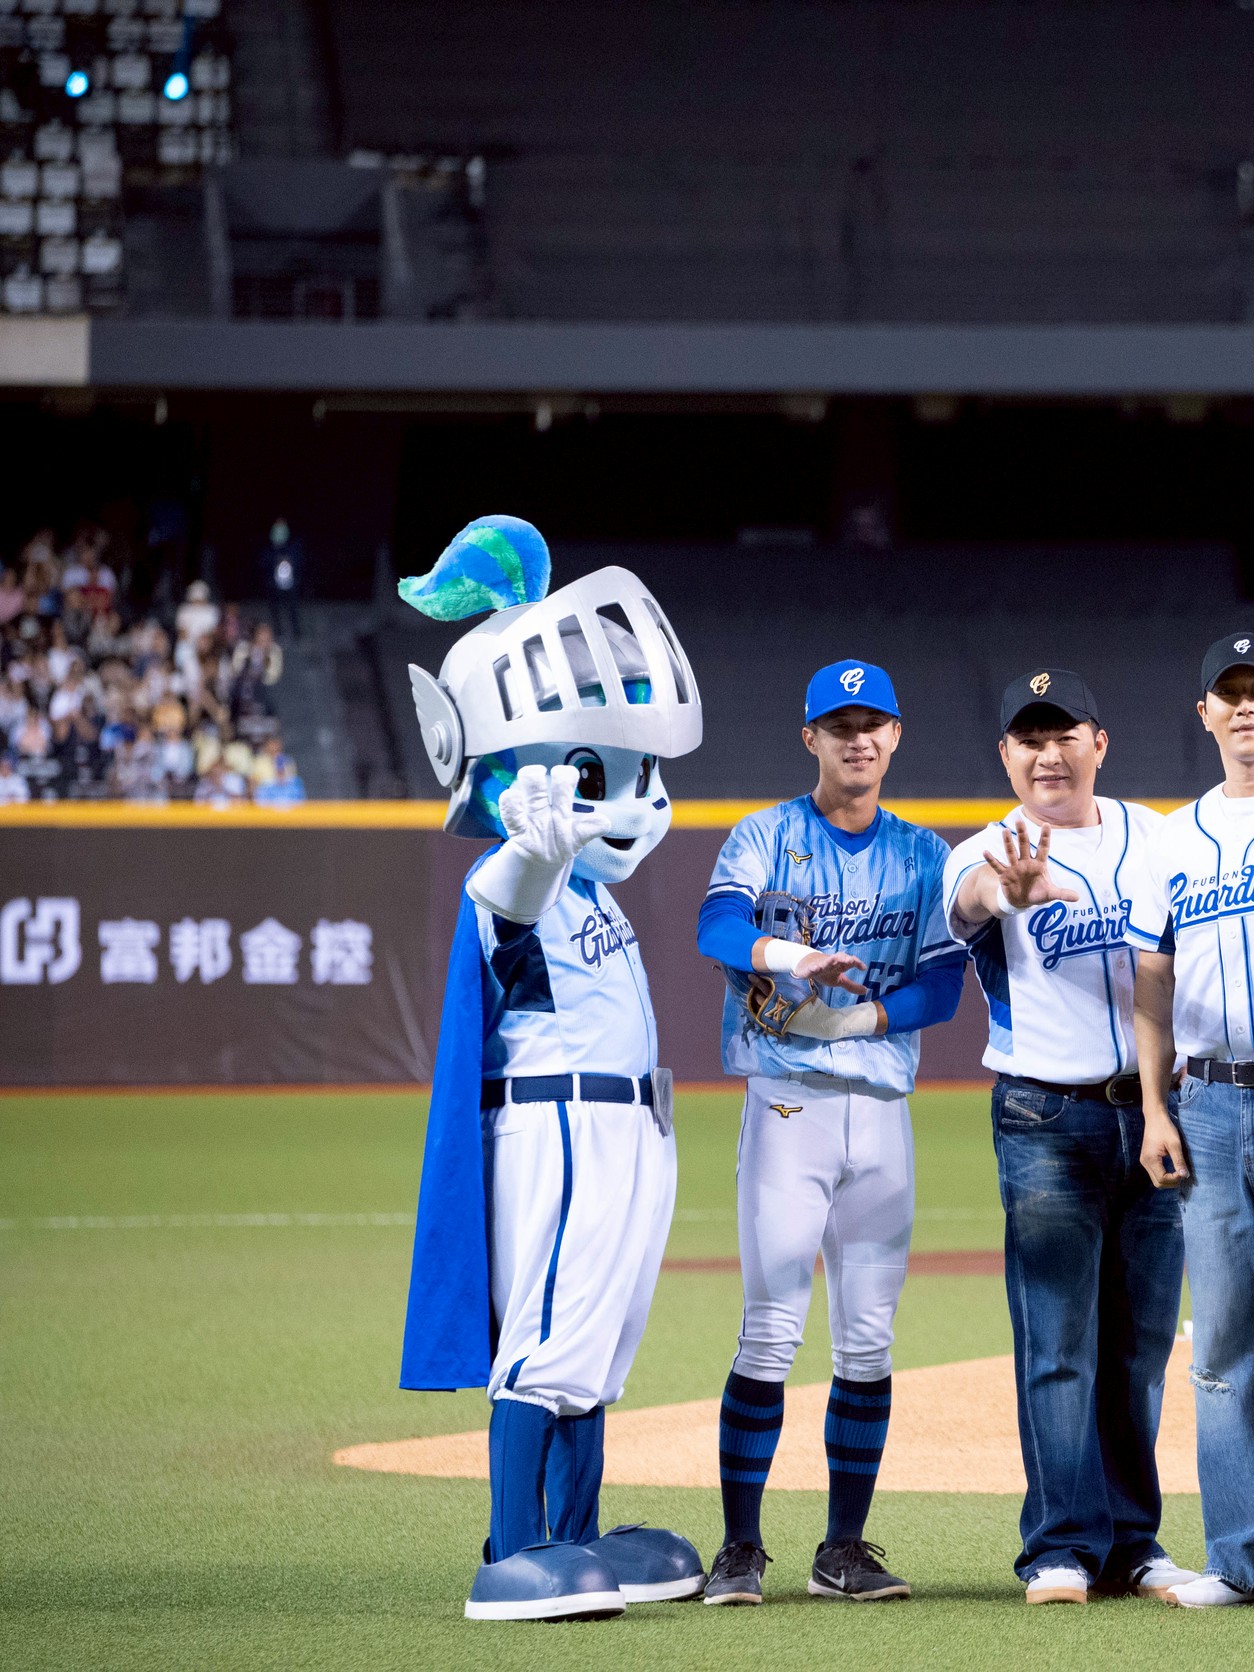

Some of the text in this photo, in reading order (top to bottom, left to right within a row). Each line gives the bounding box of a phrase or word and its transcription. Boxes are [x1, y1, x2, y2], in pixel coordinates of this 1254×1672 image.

[839, 667, 865, 696] G
[1029, 672, 1052, 697] G
[1192, 870, 1239, 889] FUBON
[1072, 904, 1118, 919] FUBON
[1028, 899, 1133, 970] Guard
